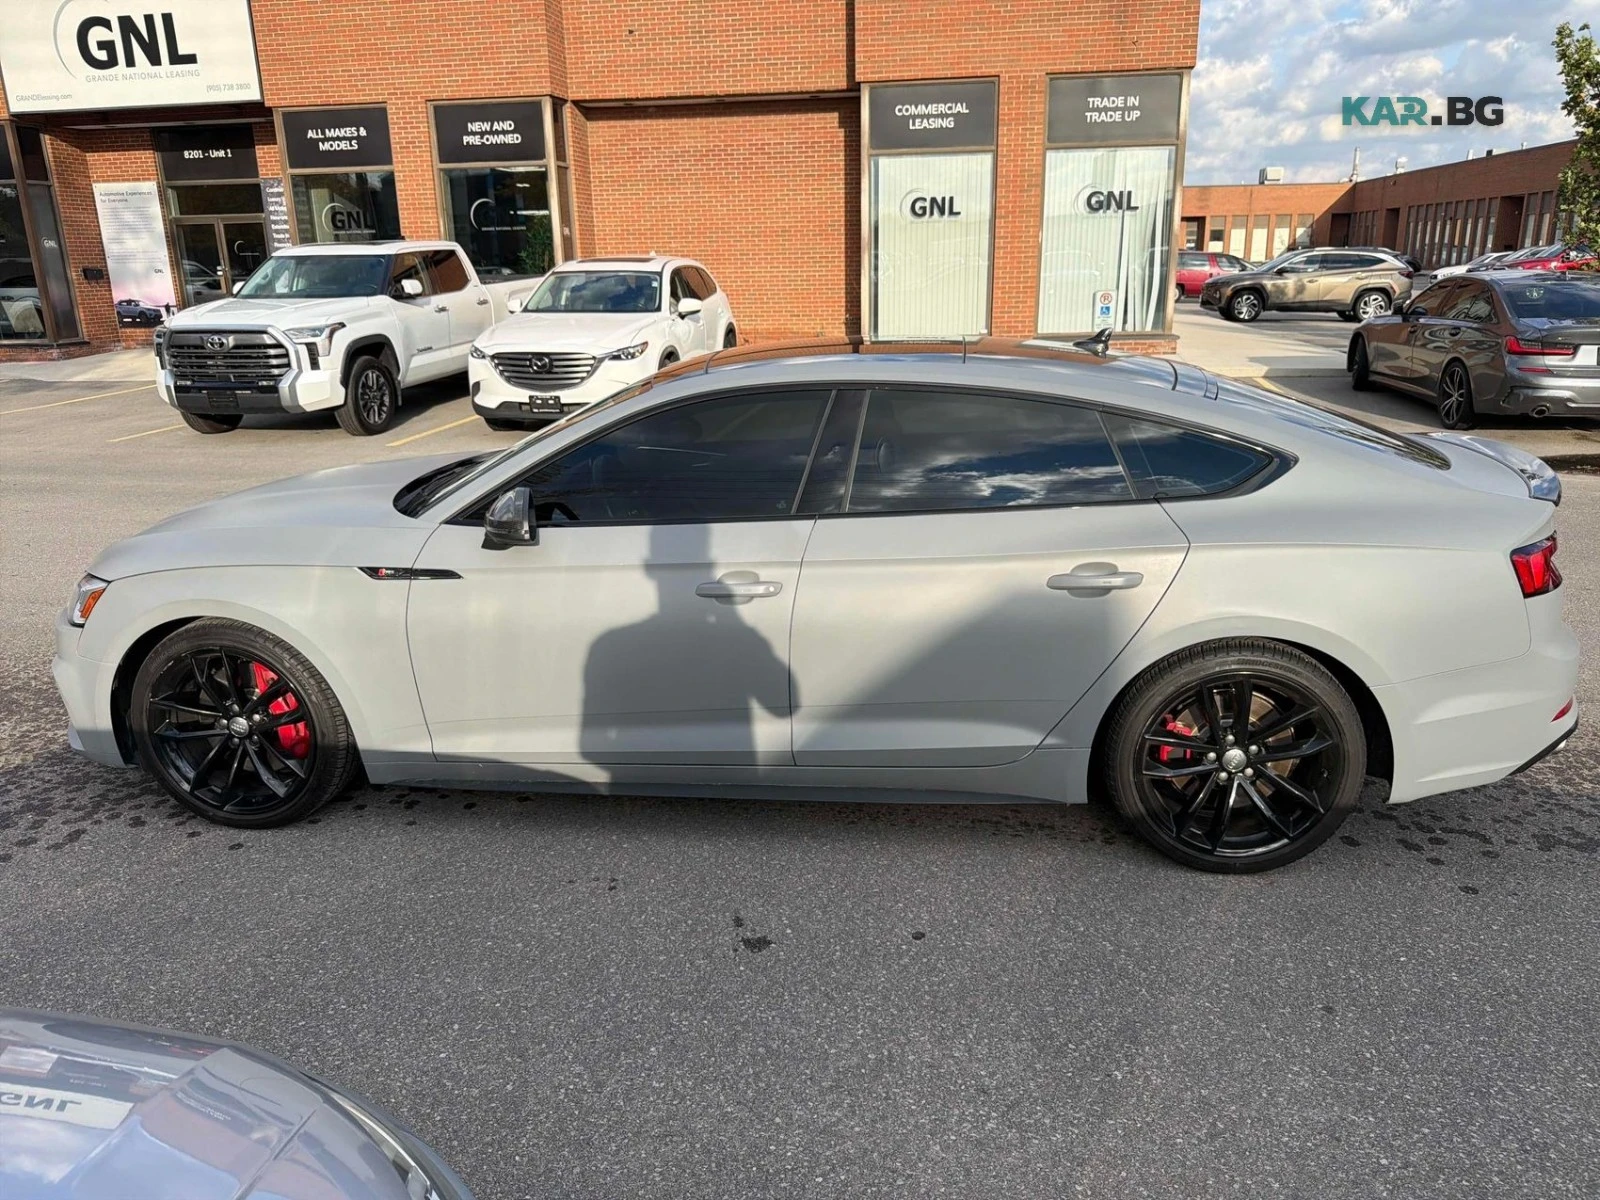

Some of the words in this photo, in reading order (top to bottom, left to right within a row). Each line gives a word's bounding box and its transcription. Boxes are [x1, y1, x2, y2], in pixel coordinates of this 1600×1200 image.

[76, 12, 198, 71] GNL
[85, 73, 119, 83] GRANDE
[121, 71, 164, 82] NATIONAL
[165, 69, 200, 80] LEASING
[15, 93, 73, 103] GRANDEleasing.com
[1087, 97, 1125, 108] TRADE
[1127, 96, 1139, 107] IN
[895, 102, 969, 116] COMMERCIAL
[1085, 111, 1122, 123] TRADE
[1124, 110, 1141, 122] UP
[467, 121, 490, 132] NEW
[492, 121, 514, 131] AND
[909, 117, 955, 130] LEASING
[307, 128, 324, 139] ALL
[325, 126, 357, 138] MAKES
[359, 126, 367, 136] &
[318, 140, 358, 151] MODELS
[463, 134, 521, 146] PRE-OWNED
[183, 150, 203, 159] 8201
[210, 149, 226, 158] Unit
[227, 149, 232, 157] 1
[910, 195, 961, 218] GNL
[1086, 190, 1139, 214] GNL
[331, 211, 374, 229] GNL
